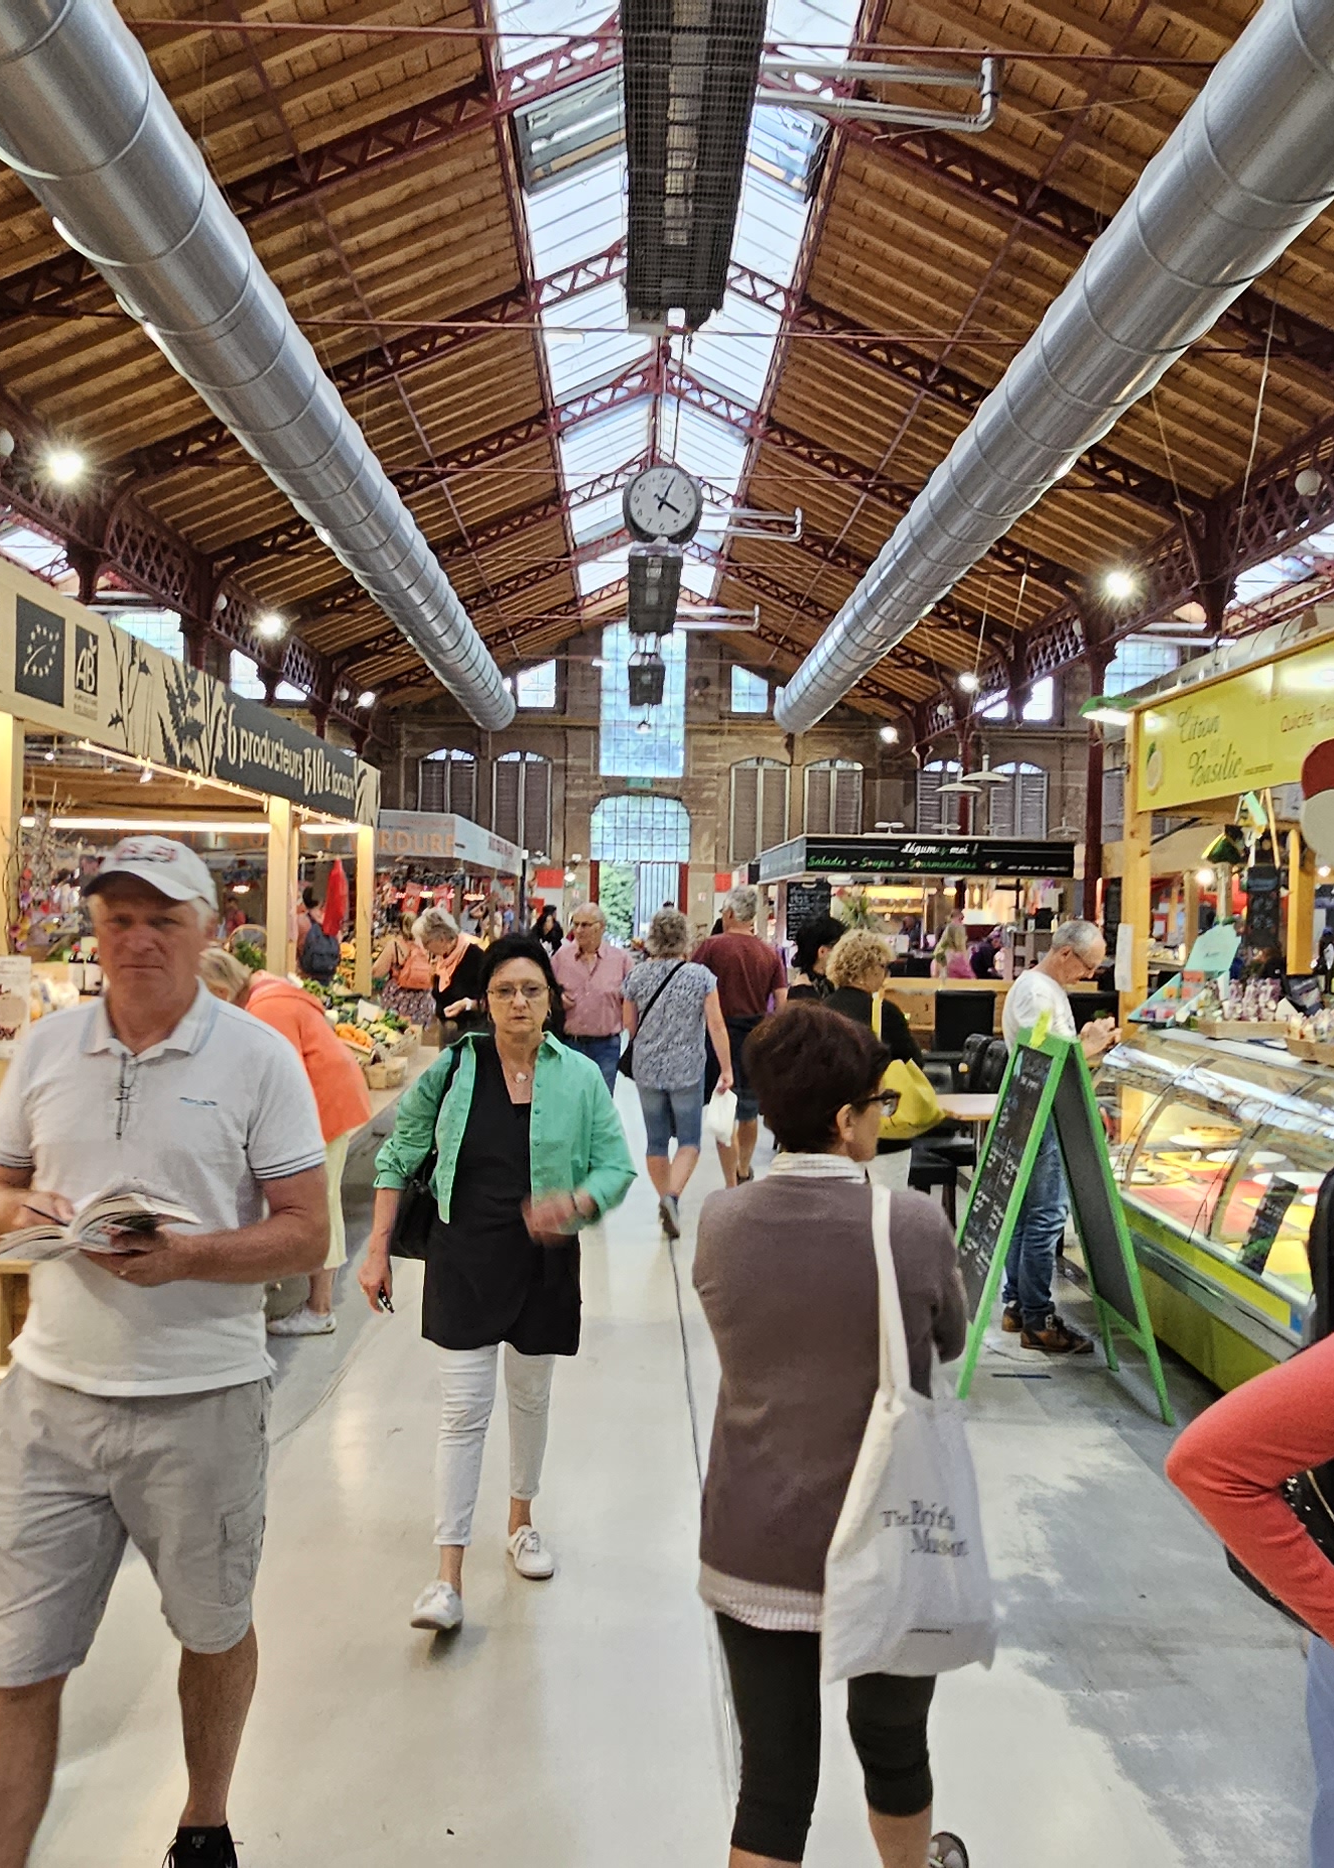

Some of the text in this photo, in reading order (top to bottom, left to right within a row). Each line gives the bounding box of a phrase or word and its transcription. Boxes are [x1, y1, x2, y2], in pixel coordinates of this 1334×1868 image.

[76, 647, 96, 693] AB
[227, 703, 236, 766] 6
[239, 728, 302, 781] producteurs
[304, 747, 324, 796] BIO
[1188, 742, 1243, 787] Basilic
[807, 855, 847, 867] Salades
[859, 857, 896, 869] Soupes
[907, 857, 978, 869] Gourmandises
